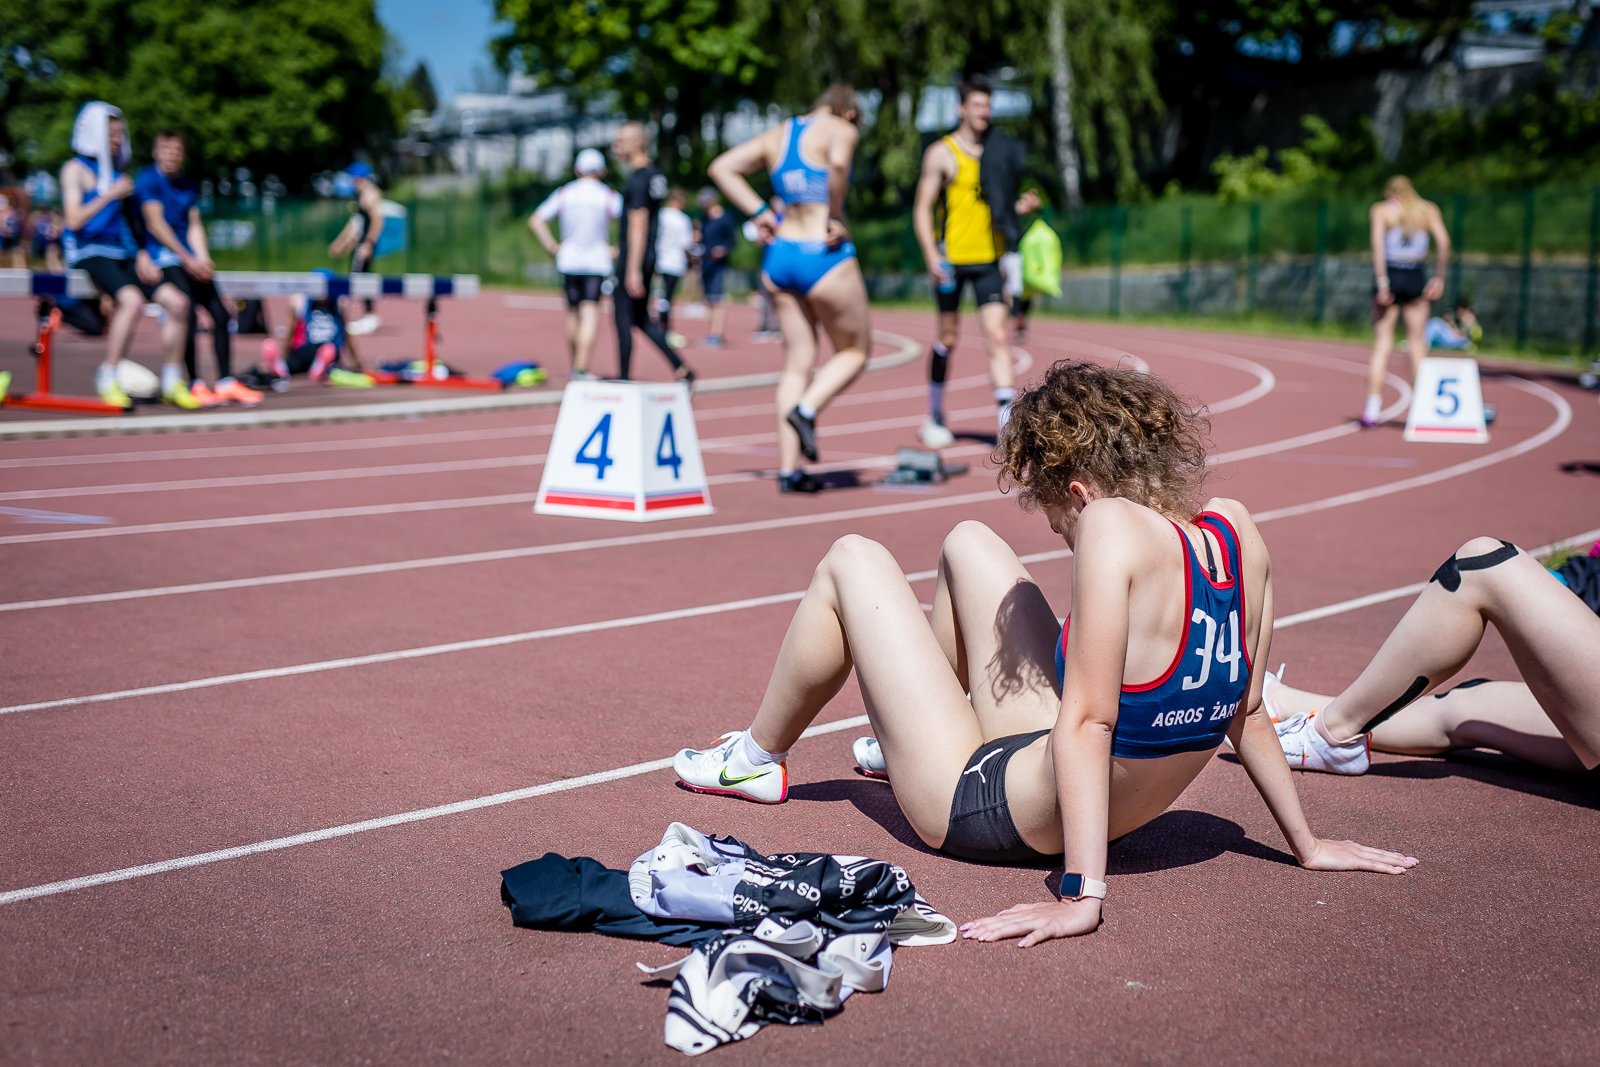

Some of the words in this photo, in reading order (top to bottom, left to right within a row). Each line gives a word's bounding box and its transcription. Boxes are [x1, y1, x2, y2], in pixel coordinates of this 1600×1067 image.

[1436, 378, 1460, 418] 5
[575, 413, 614, 480] 4
[656, 412, 683, 480] 4
[1181, 607, 1242, 691] 34
[1151, 706, 1205, 727] AGROS
